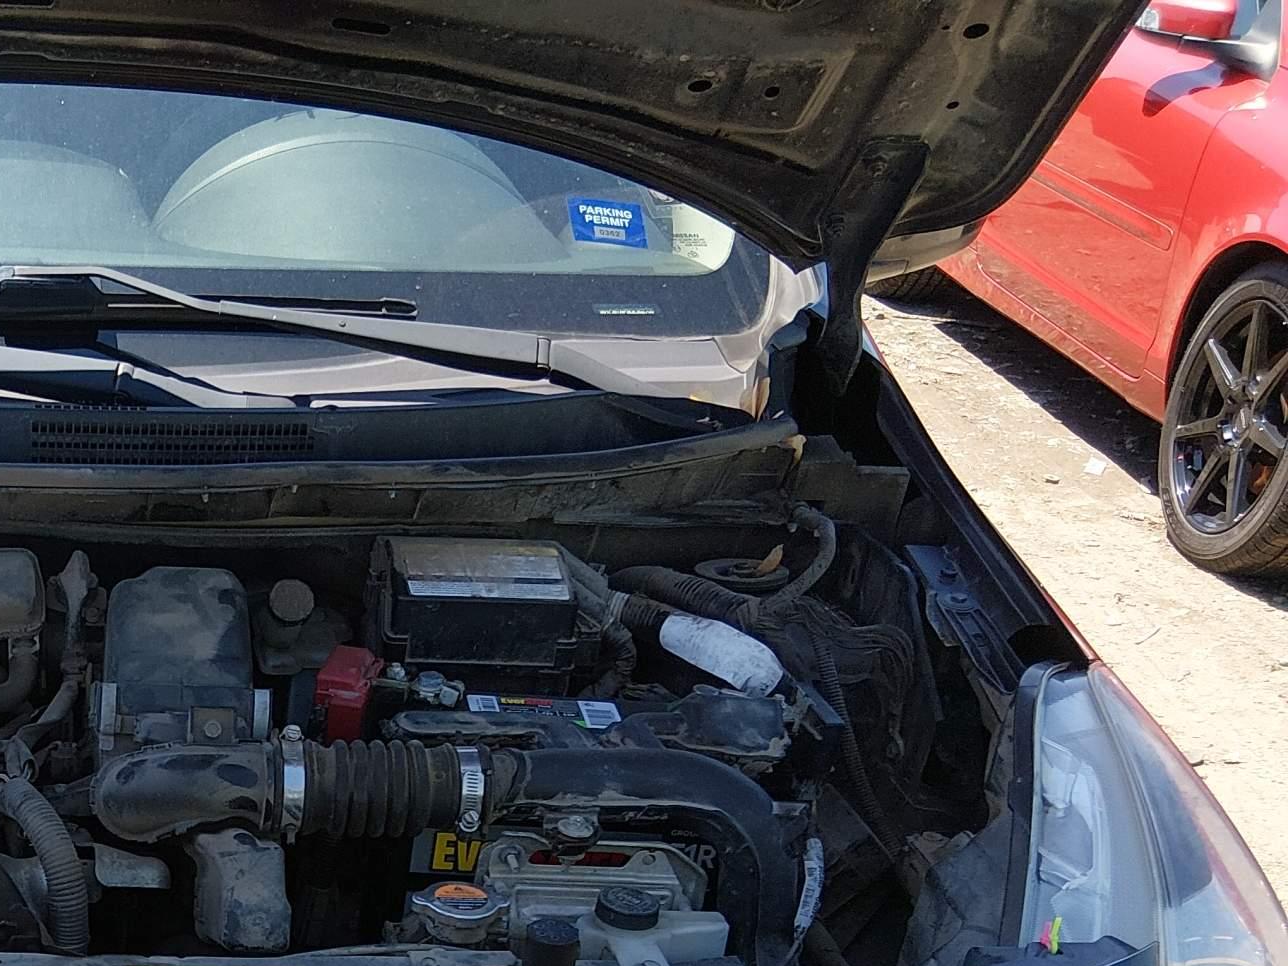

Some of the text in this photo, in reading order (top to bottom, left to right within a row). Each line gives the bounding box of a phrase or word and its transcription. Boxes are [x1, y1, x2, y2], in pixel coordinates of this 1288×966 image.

[578, 205, 633, 219] PARKING
[584, 214, 631, 228] PERMIT
[431, 831, 483, 872] EV
